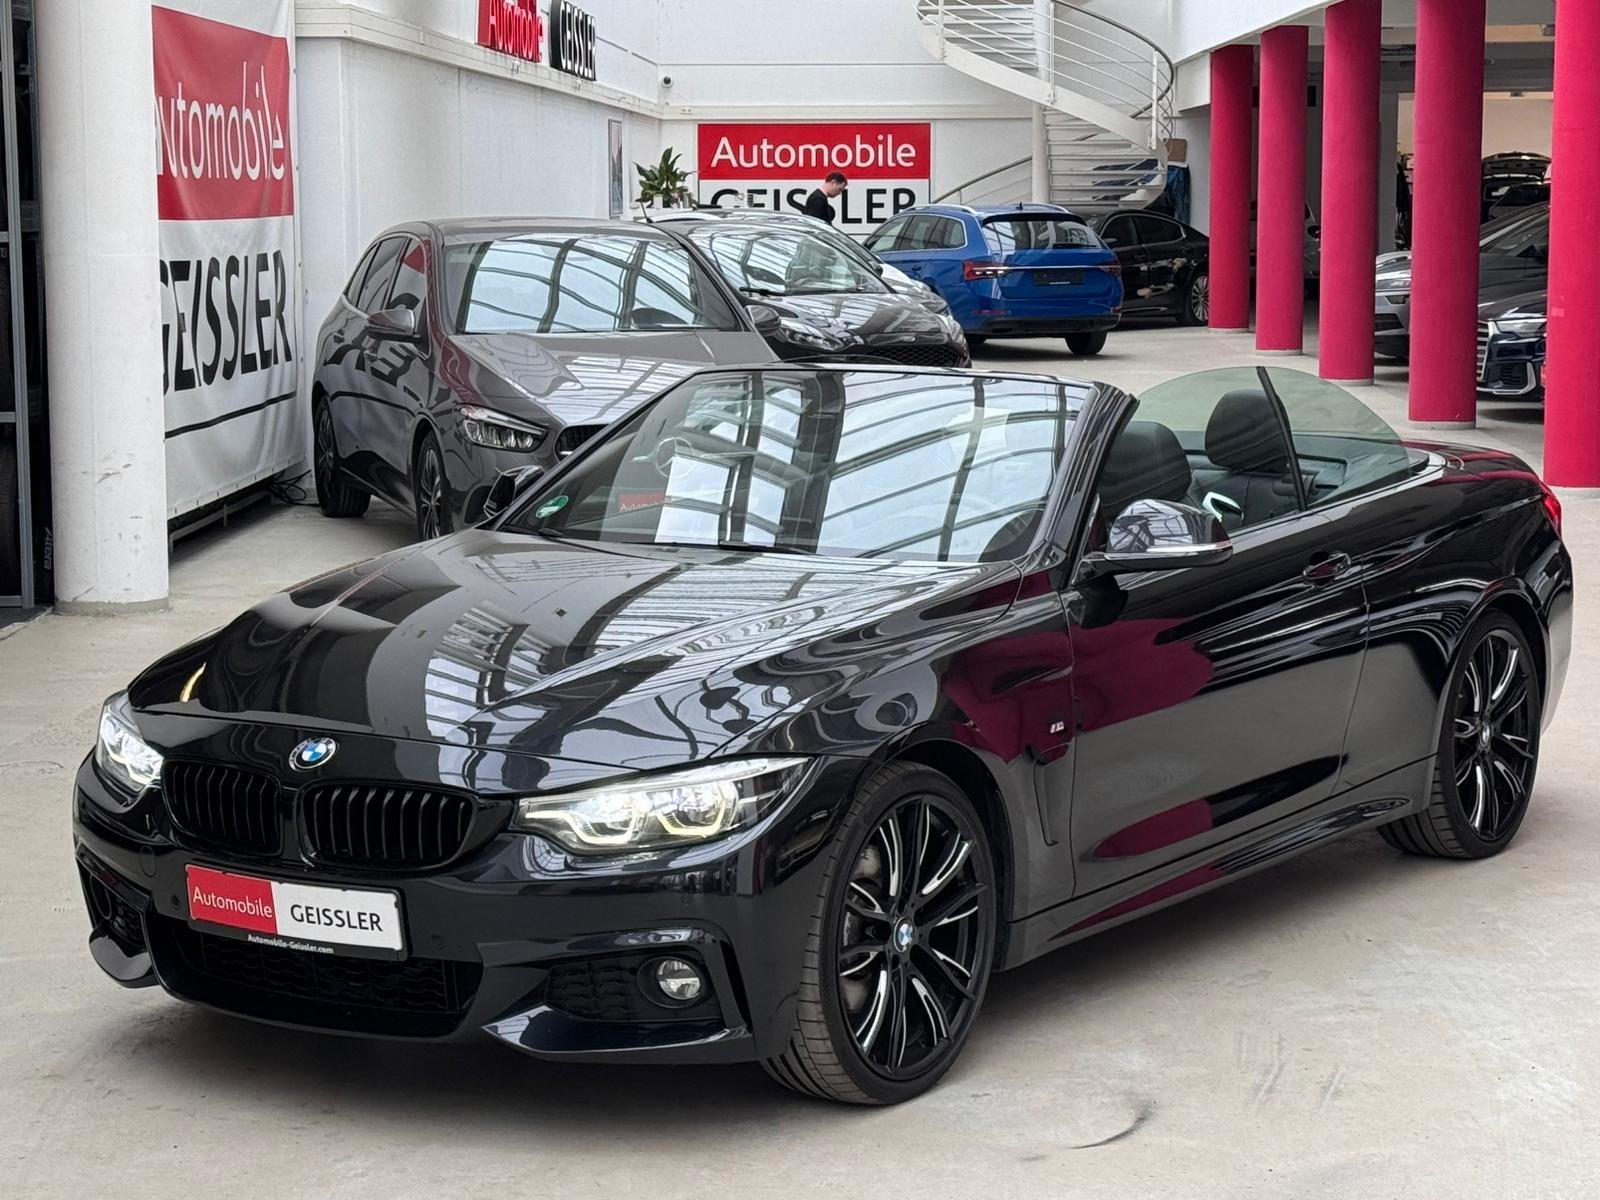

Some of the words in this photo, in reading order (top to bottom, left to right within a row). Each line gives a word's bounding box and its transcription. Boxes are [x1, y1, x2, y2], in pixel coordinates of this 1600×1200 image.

[560, 1, 596, 79] GEISSLER
[710, 134, 917, 168] Automobile
[710, 187, 917, 224] GEISLER
[192, 887, 273, 918] Automobile
[290, 904, 384, 932] GEISSLER
[247, 933, 335, 955] Automobile-Geissler.com
